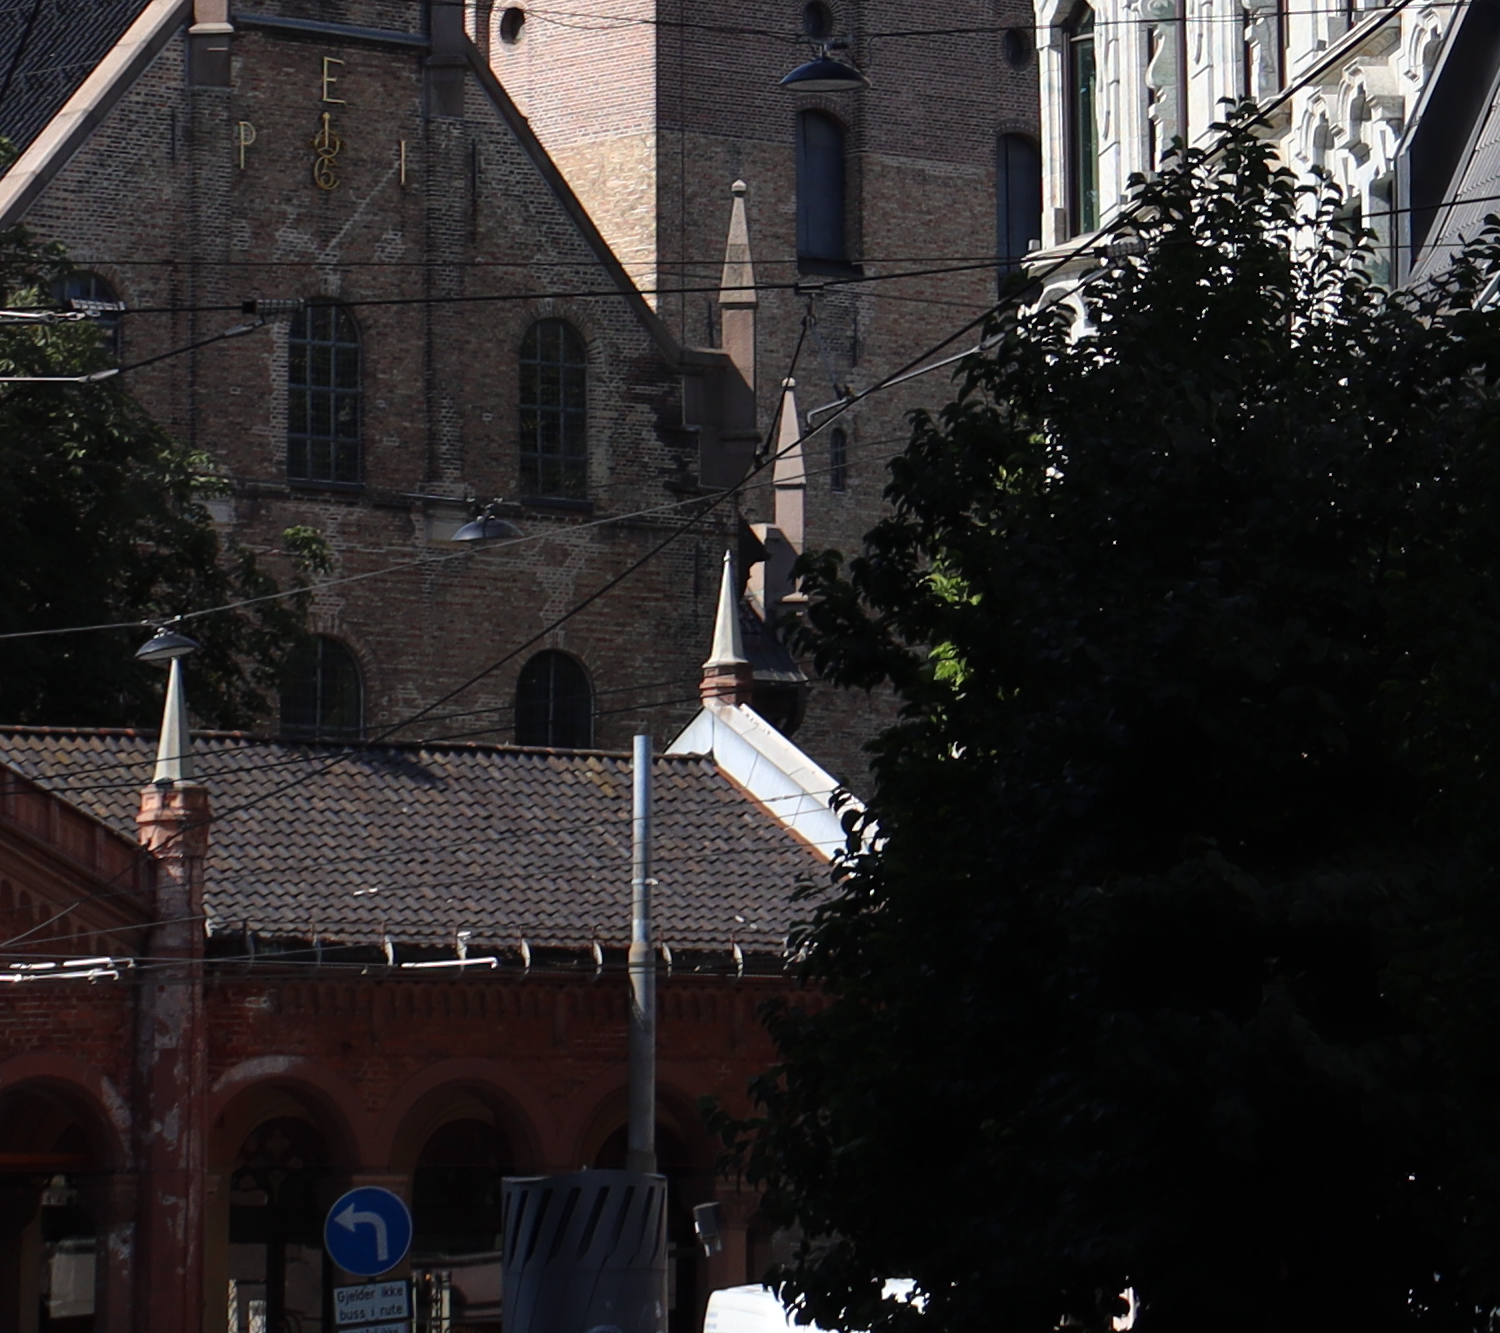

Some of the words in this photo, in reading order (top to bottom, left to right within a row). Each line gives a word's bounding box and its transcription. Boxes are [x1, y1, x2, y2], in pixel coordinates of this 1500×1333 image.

[321, 56, 346, 104] E
[238, 121, 257, 170] P
[337, 1289, 375, 1305] Gjelder
[381, 1286, 404, 1298] ikke
[340, 1308, 367, 1321] buss
[380, 1305, 404, 1316] rute
